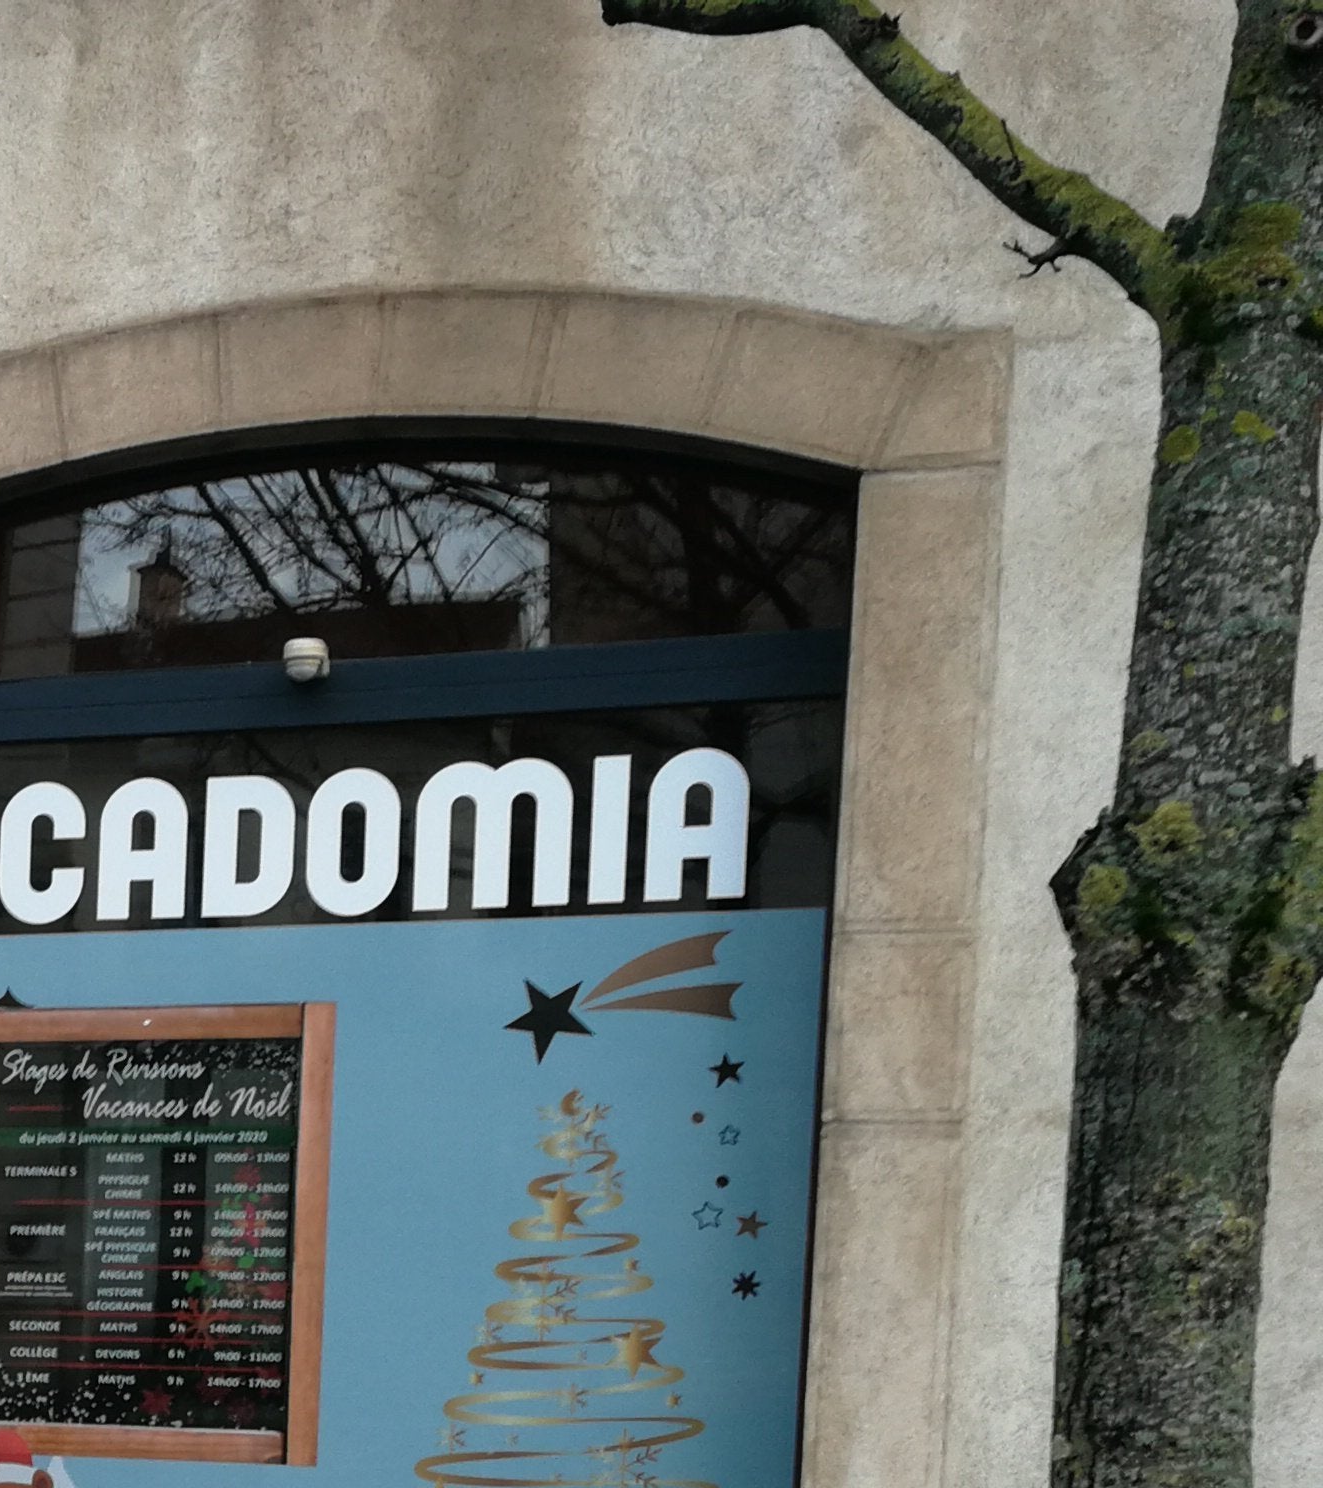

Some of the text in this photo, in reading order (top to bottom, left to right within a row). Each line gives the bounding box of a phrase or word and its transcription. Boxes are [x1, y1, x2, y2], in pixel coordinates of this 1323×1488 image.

[2, 1048, 206, 1095] Stages de Révisions
[82, 1081, 294, 1119] Vacances de Noël
[19, 1130, 268, 1146] du jeudi 2 janvier au samedi 4 janvier 2020
[106, 1152, 145, 1163] MATHS
[5, 1165, 77, 1177] TERMINALE S
[98, 1174, 150, 1185] PHYSIQUE
[105, 1188, 143, 1200] CHIMIE
[113, 1209, 152, 1220] MATHS
[10, 1223, 66, 1236] PREMIÈRE
[95, 1226, 146, 1238] FRANÇAIS
[105, 1241, 158, 1253] PHYSIQUE
[101, 1253, 140, 1264] CHIMIE
[7, 1270, 43, 1283] PRÉPA
[99, 1270, 144, 1280] ANGLAIS
[97, 1287, 144, 1297] HISTOIRE
[86, 1300, 154, 1312] GÉOGRAPHIE
[9, 1320, 61, 1332] SECONDE
[100, 1322, 138, 1333] MATHS
[169, 1323, 176, 1333] 9
[209, 1323, 242, 1334] 14h00
[251, 1324, 283, 1335] 17h00
[10, 1346, 58, 1358] COLLÈGE
[95, 1349, 141, 1360] DEVOIRS
[214, 1352, 240, 1362] 9h00
[98, 1374, 136, 1385] MATHS
[167, 1376, 174, 1386] 9
[207, 1377, 240, 1387] 14h00
[248, 1378, 281, 1388] 17h00
